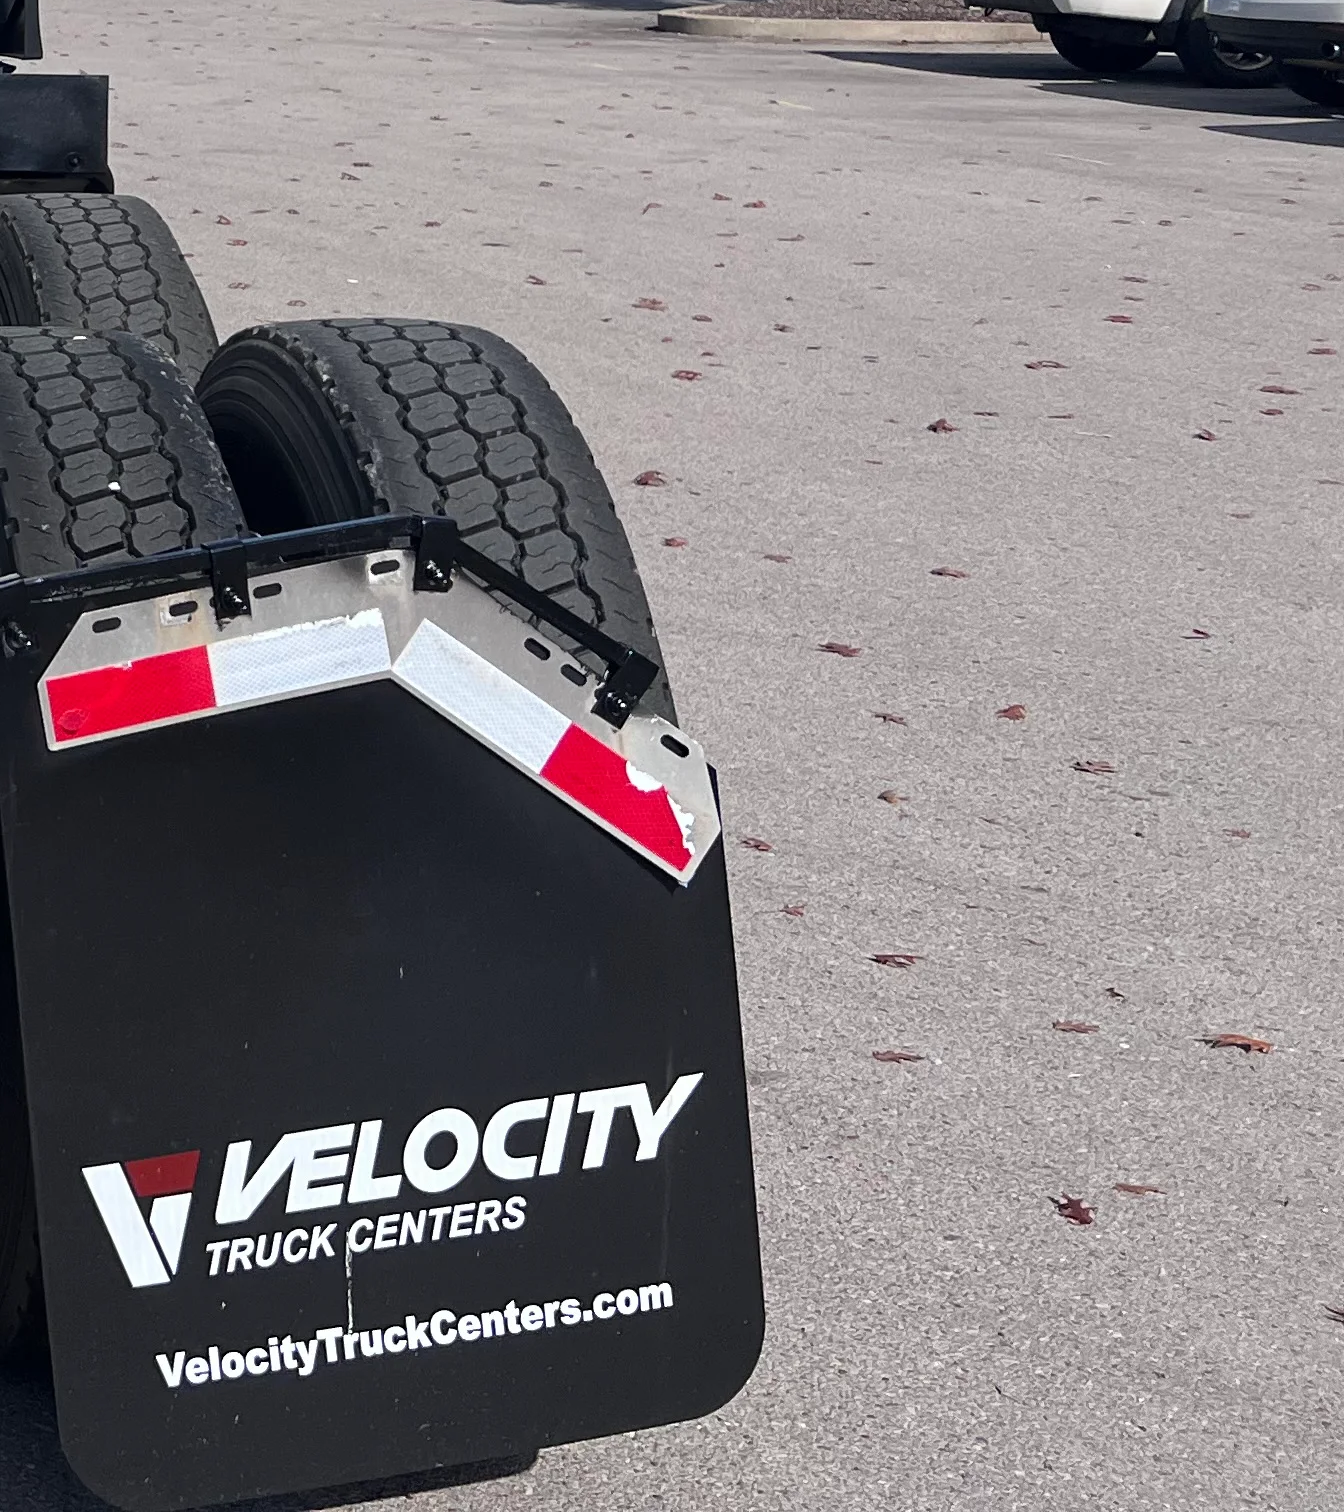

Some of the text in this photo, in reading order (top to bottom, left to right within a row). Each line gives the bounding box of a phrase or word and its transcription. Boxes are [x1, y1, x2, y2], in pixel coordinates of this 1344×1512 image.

[216, 1073, 703, 1225] VELOCITY
[205, 1196, 527, 1276] TRUCK CENTERS
[156, 1282, 674, 1388] VelocityTruckCenters.com
